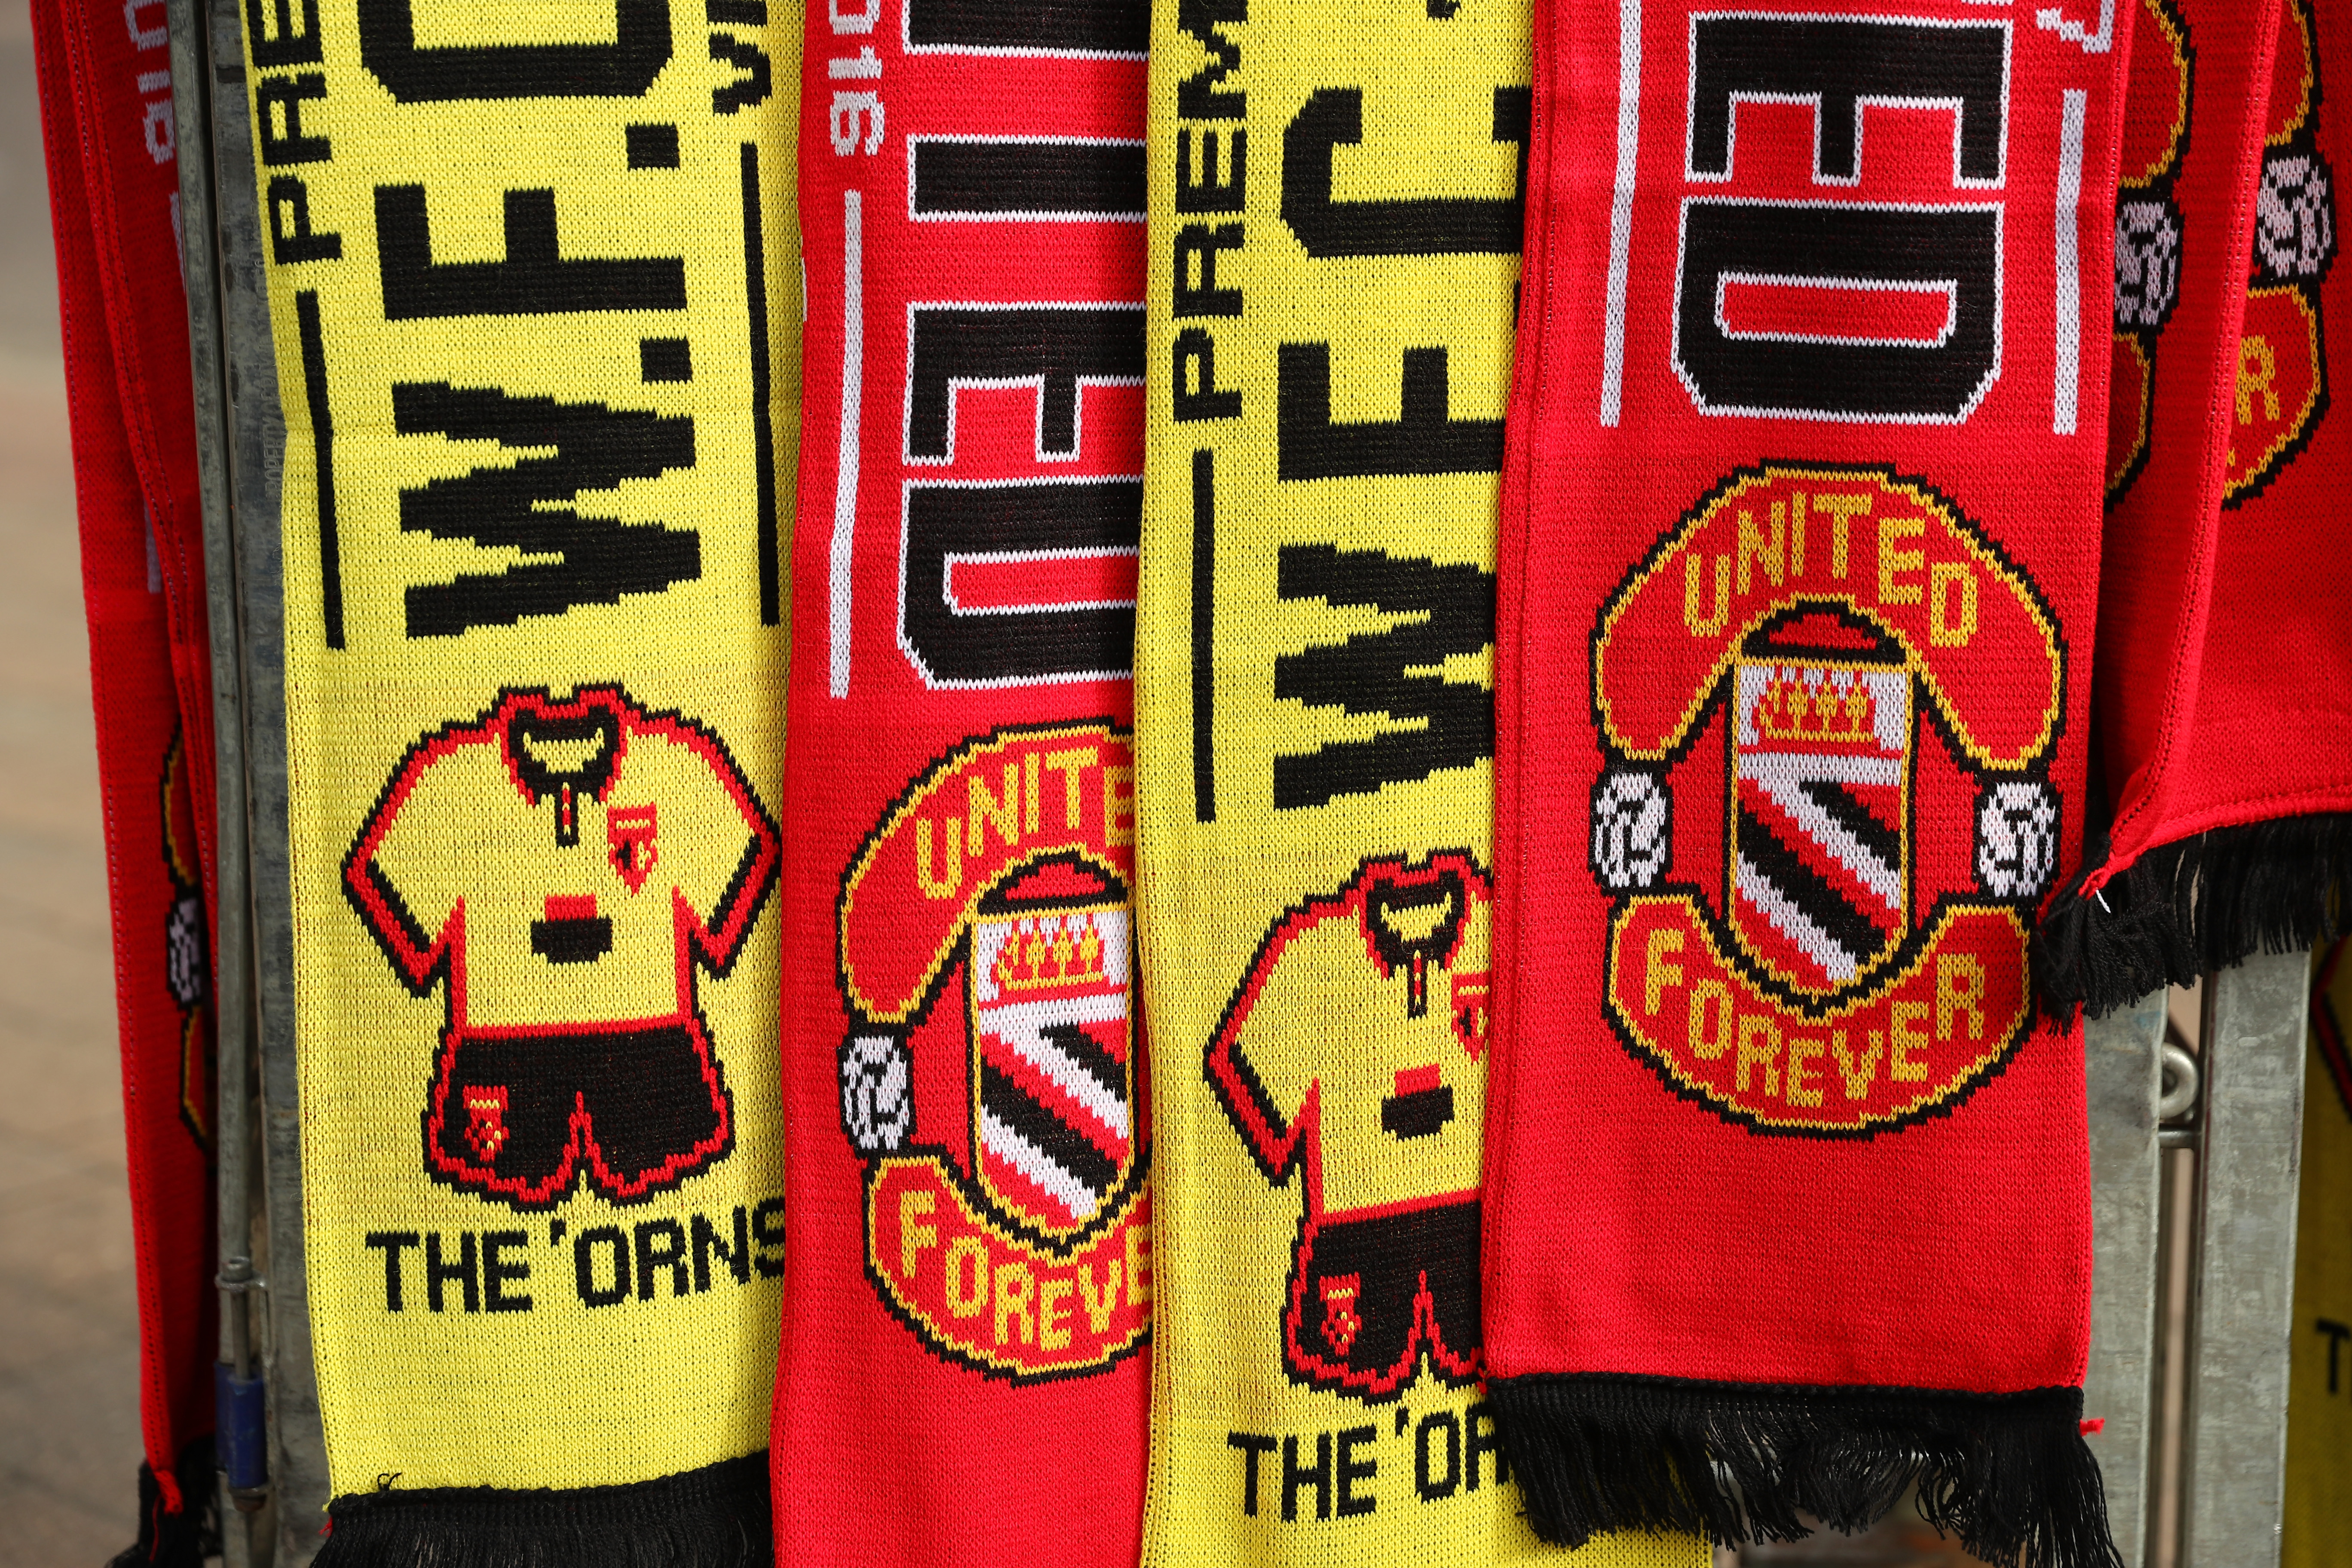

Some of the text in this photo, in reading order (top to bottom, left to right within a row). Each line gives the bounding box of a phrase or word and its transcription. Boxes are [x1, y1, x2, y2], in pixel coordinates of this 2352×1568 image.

[1684, 492, 1978, 647] UNITED
[1644, 928, 1986, 1108] FOREVER
[365, 1230, 533, 1314] THE
[1228, 1424, 1376, 1522] THE
